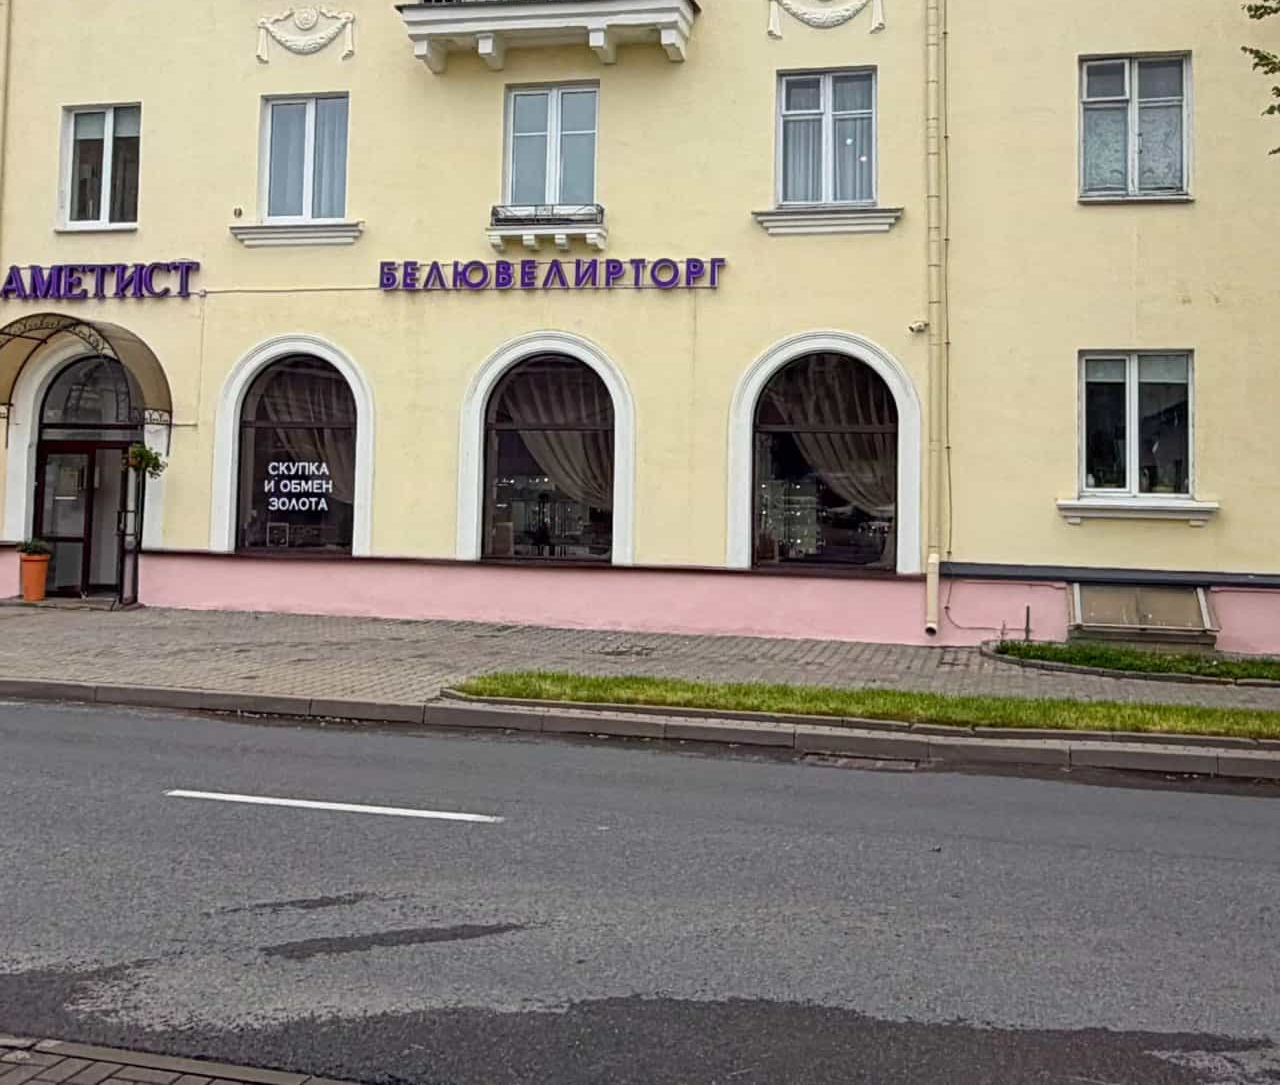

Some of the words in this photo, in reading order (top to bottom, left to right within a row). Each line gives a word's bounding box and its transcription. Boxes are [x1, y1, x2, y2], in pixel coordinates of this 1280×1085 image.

[379, 257, 726, 289] БЕЛЮВЕЛИРТОРГ
[0, 262, 200, 299] АМЕТИСТ
[267, 461, 330, 475] СКУПКА
[264, 480, 275, 493] И
[280, 480, 333, 493] ОБМЕН
[267, 497, 329, 511] ЗОЛОТА
